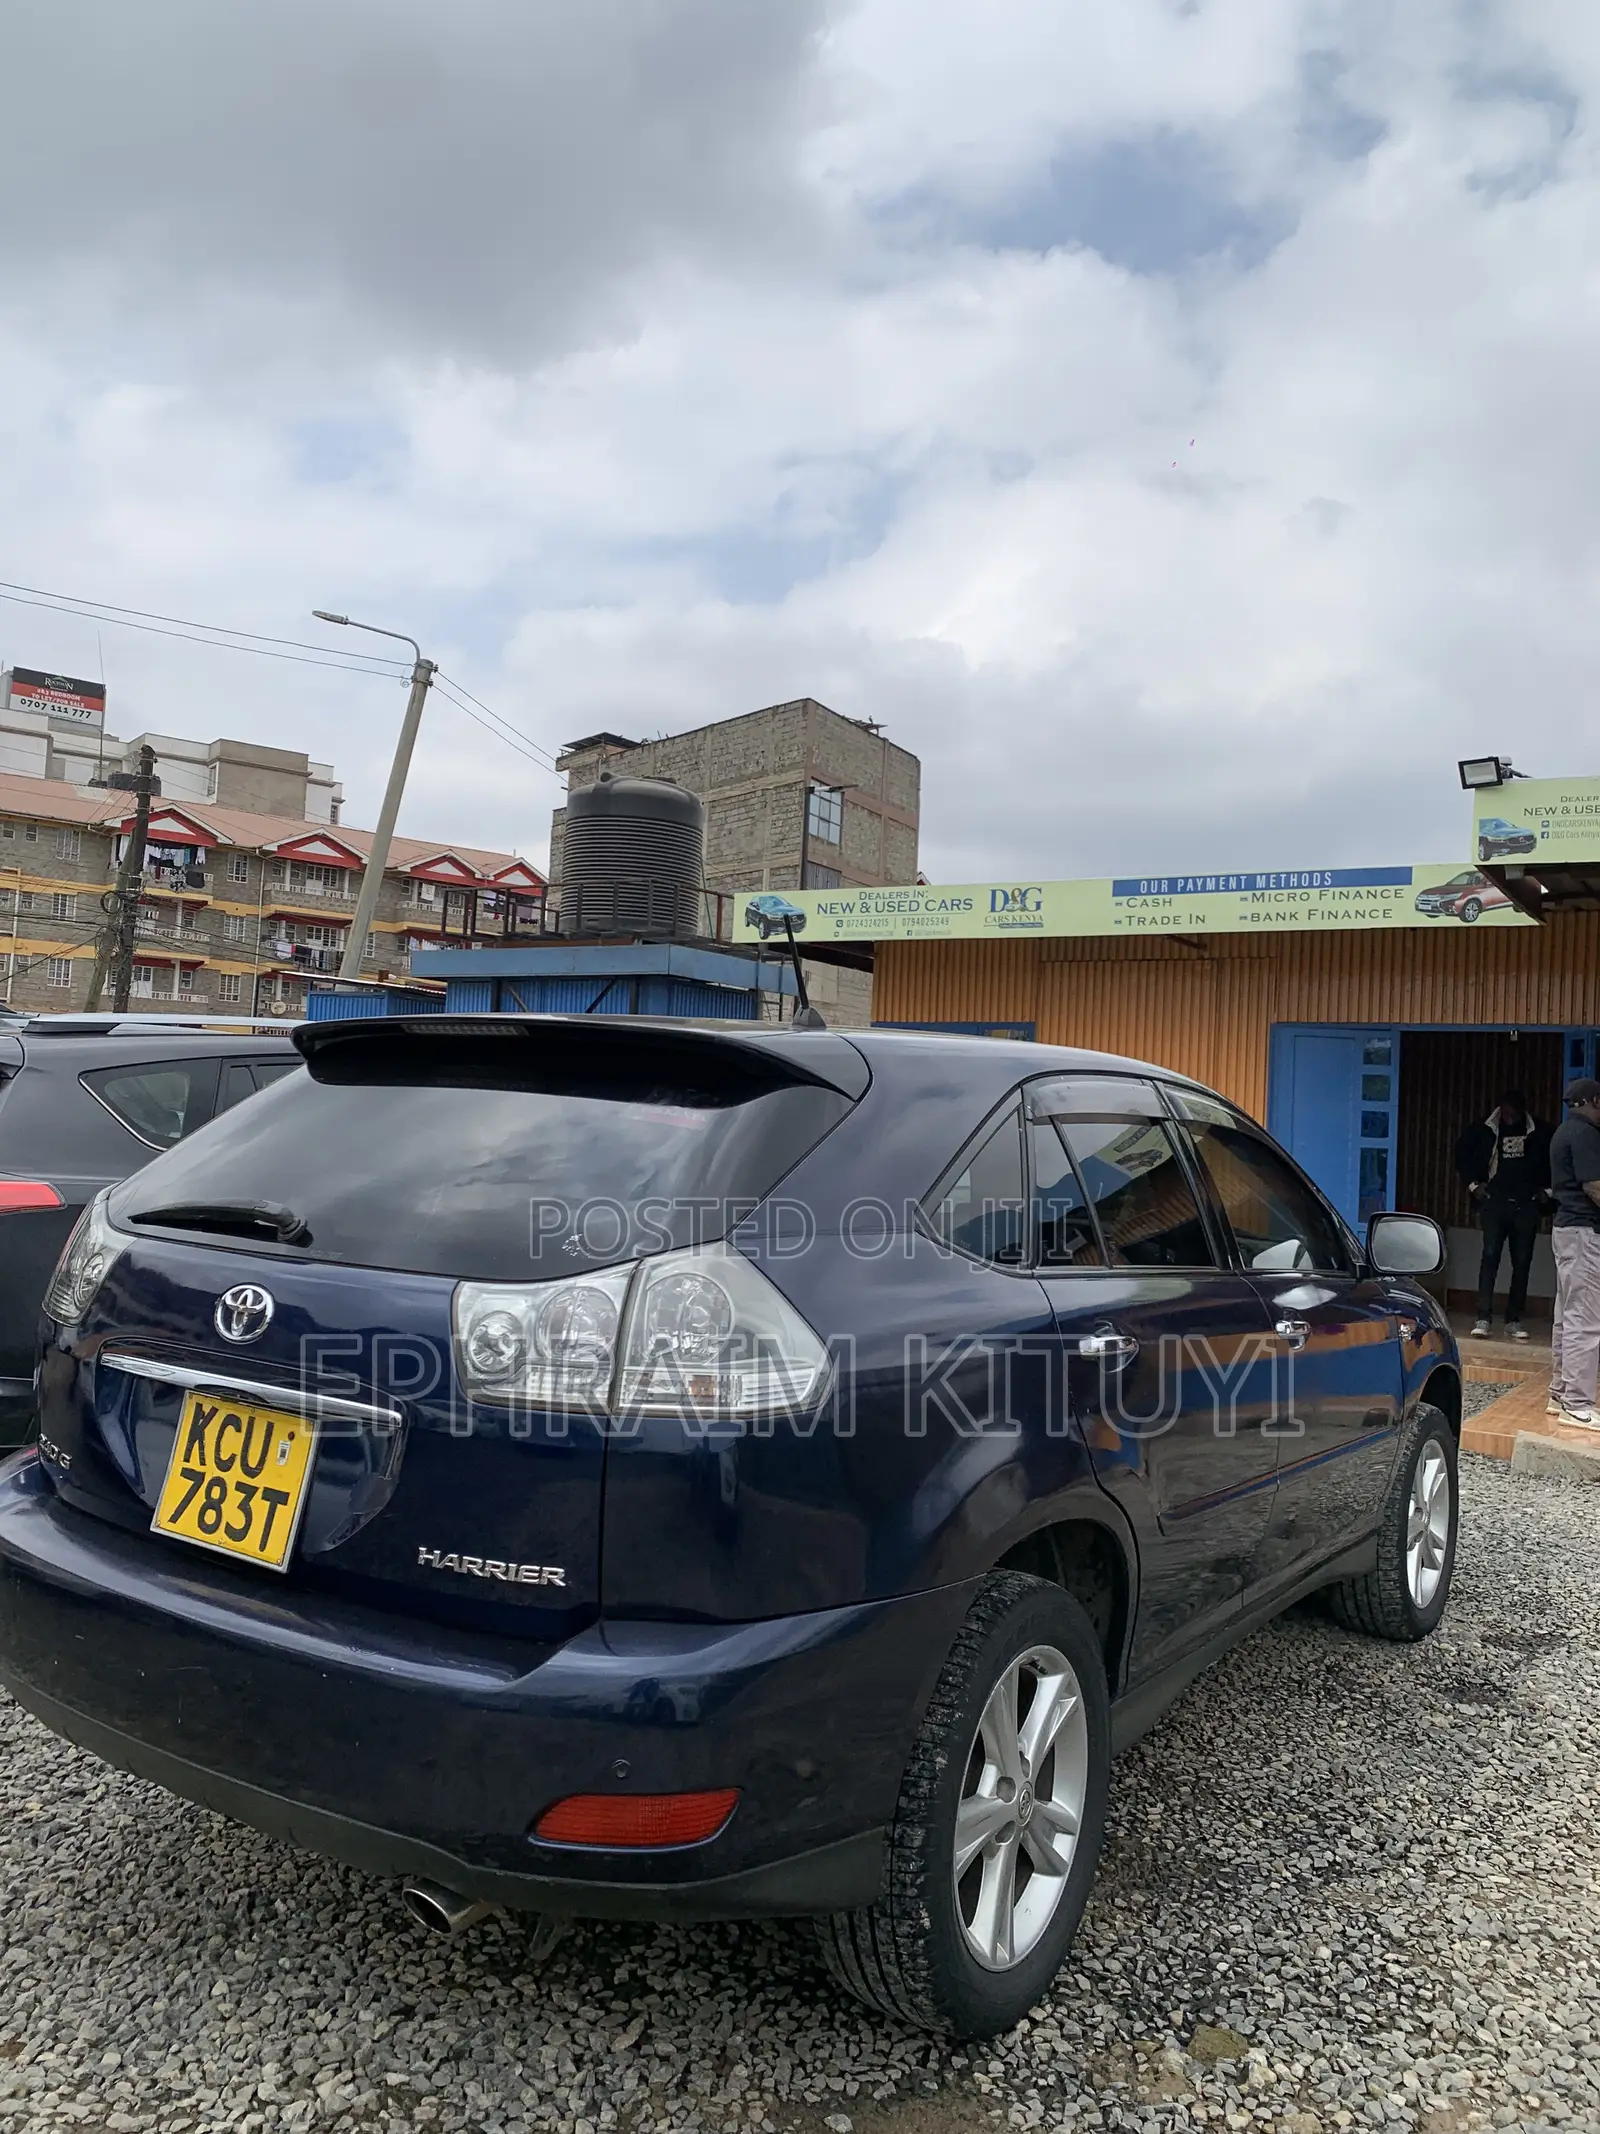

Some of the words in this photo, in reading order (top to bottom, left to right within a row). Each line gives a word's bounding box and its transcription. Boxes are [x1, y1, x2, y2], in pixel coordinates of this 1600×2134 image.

[50, 690, 81, 701] BEDROOM
[20, 698, 47, 710] 0707
[51, 705, 68, 714] 111
[72, 708, 92, 719] 777
[70, 700, 85, 708] SALE
[1524, 807, 1558, 816] NEW
[1561, 806, 1571, 815] &
[1140, 880, 1168, 894] OUR
[1178, 876, 1247, 892] PAYMENT
[1256, 872, 1332, 888] METHODS
[858, 890, 910, 900] DEALERS
[913, 890, 928, 899] IN:
[988, 887, 1044, 913] D&G
[1252, 892, 1310, 903] MICRO
[1319, 889, 1404, 900] FINANCE
[817, 901, 856, 915] NEW
[860, 902, 870, 913] &
[875, 900, 920, 913] USED
[924, 898, 973, 912] CARS
[1126, 897, 1172, 908] CASH
[984, 915, 1009, 924] CARS
[1011, 914, 1044, 923] KENYA
[1125, 915, 1182, 926] TRADE
[1189, 913, 1206, 924] IN
[1251, 911, 1299, 922] BANK
[1308, 909, 1393, 920] FINANCE
[182, 1402, 275, 1479] KCU
[168, 1467, 290, 1552] 783T
[417, 1546, 568, 1588] HARRIER
